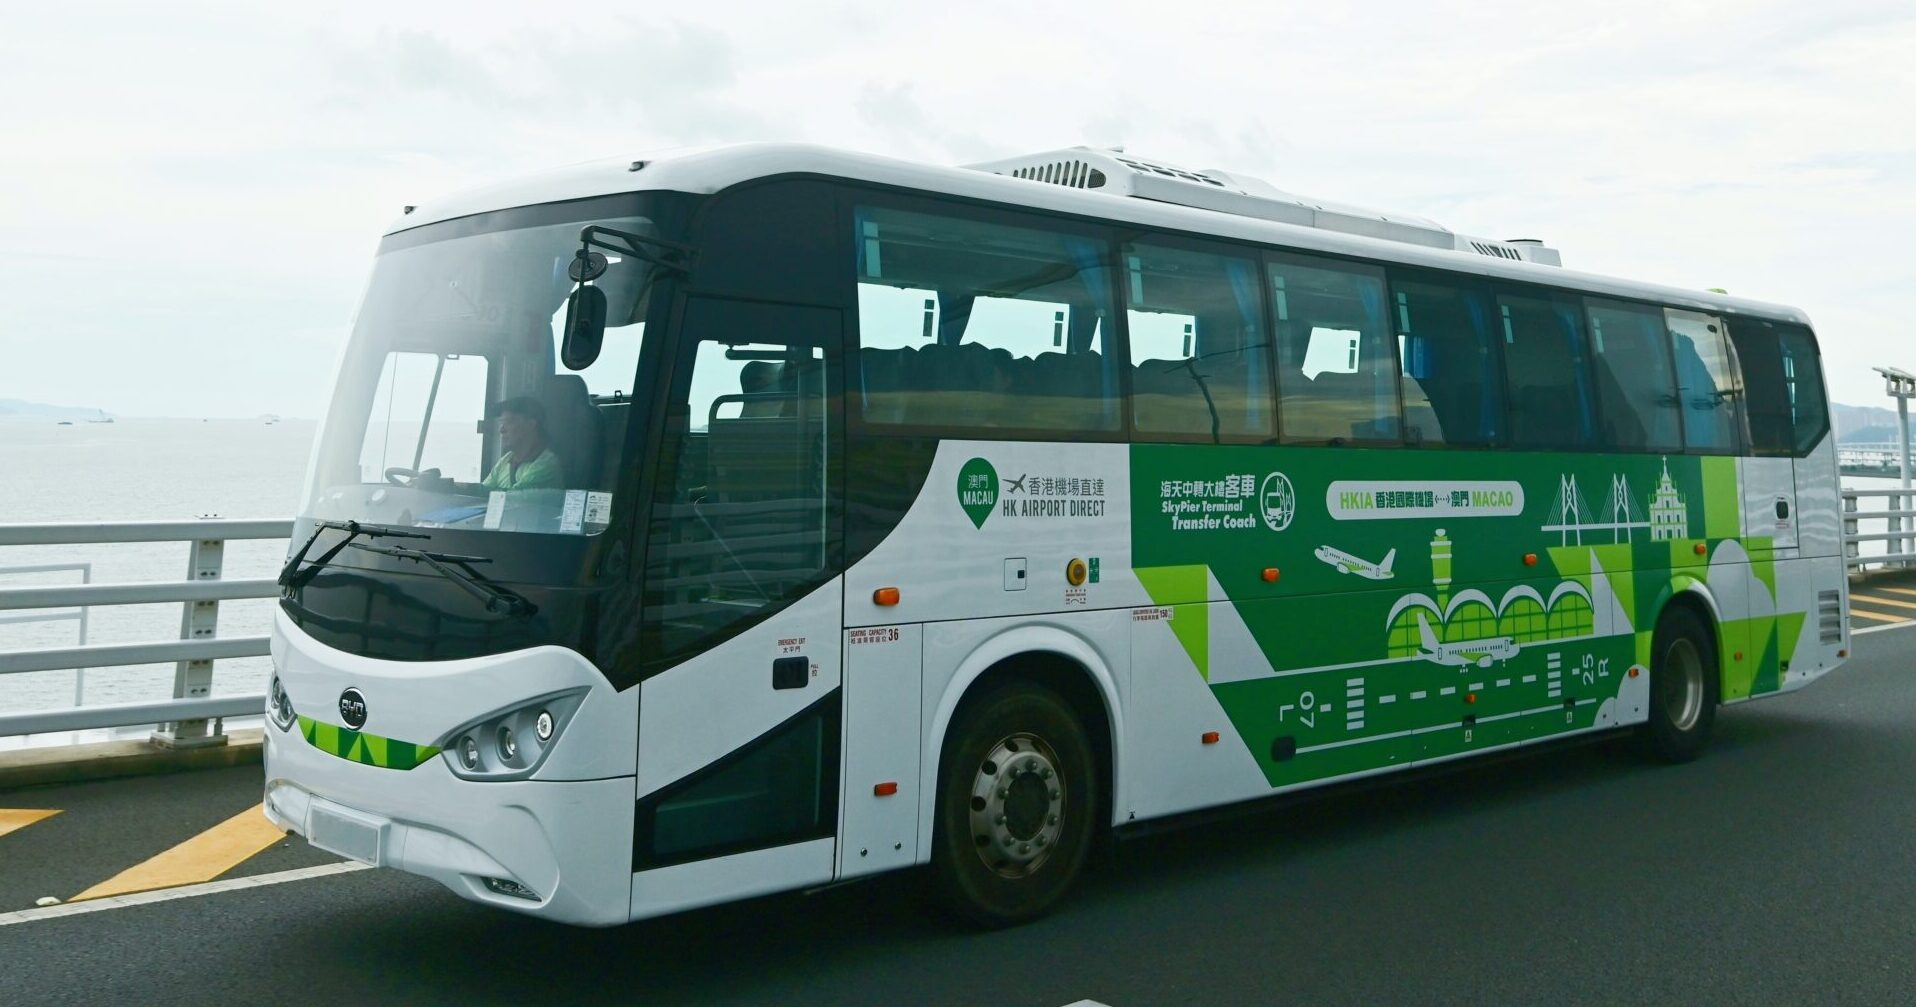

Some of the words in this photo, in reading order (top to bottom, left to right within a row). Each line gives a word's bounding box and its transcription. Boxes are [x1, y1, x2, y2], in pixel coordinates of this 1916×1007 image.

[968, 474, 989, 489] 澳門
[1028, 477, 1105, 496] 香港機場直達
[963, 490, 994, 505] MACAU
[1339, 492, 1374, 509] HKIA
[1375, 491, 1434, 509] 香港國際機場
[1450, 491, 1470, 507] 澳門
[1472, 491, 1514, 506] MACAO
[1002, 500, 1018, 517] HK
[1021, 500, 1067, 517] AIRPORT
[1070, 500, 1105, 517] DIRECT
[1161, 500, 1201, 514] SkyPier
[1202, 500, 1243, 513] Terminal
[1171, 514, 1221, 530] Transfer
[1223, 513, 1256, 528] Coach
[850, 629, 867, 637] SEATING
[868, 628, 887, 636] CAPACITY
[888, 628, 899, 641] 36
[1582, 653, 1594, 686] 25
[1598, 657, 1609, 678] R
[342, 698, 364, 717] BYD
[1279, 704, 1295, 722] L
[1300, 691, 1314, 728] 07
